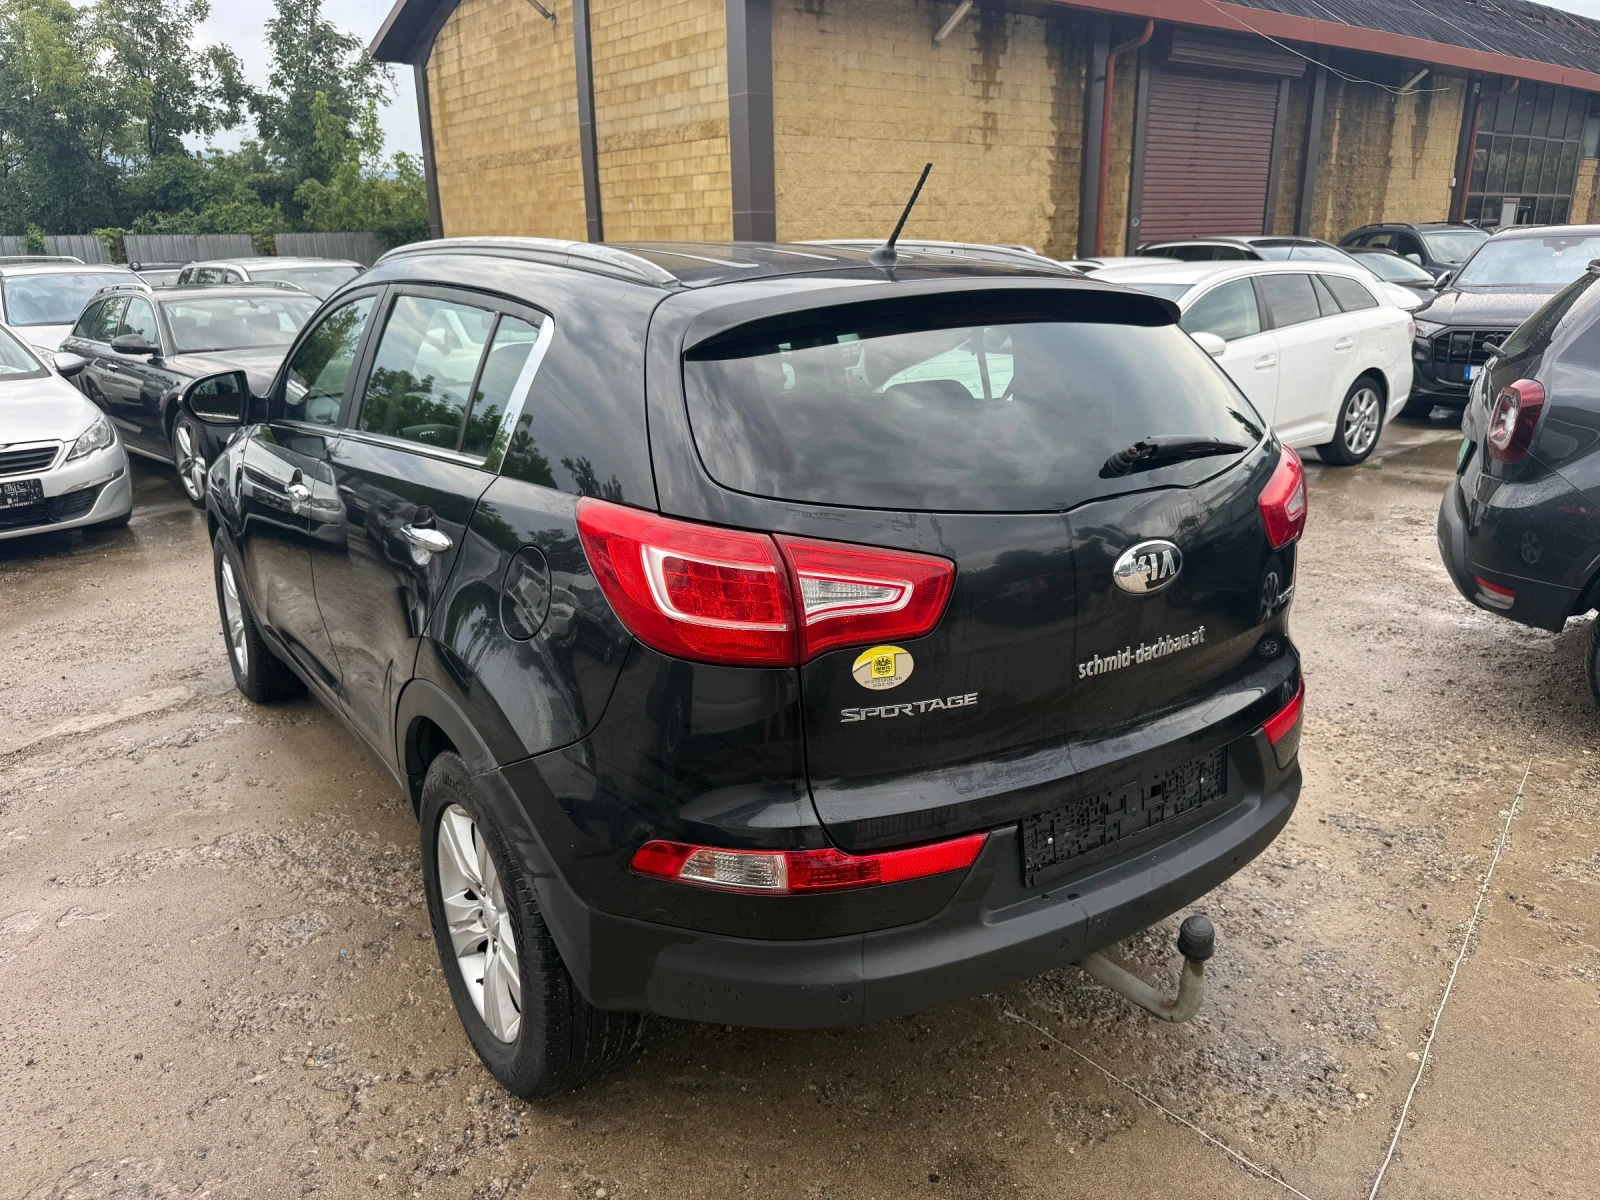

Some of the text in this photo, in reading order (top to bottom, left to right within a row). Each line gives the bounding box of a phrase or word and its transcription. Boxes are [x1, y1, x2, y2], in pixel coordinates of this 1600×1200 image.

[1128, 549, 1176, 581] KIA
[1078, 625, 1206, 680] schmid-dachbau.at
[840, 692, 979, 723] SPORTAGE
